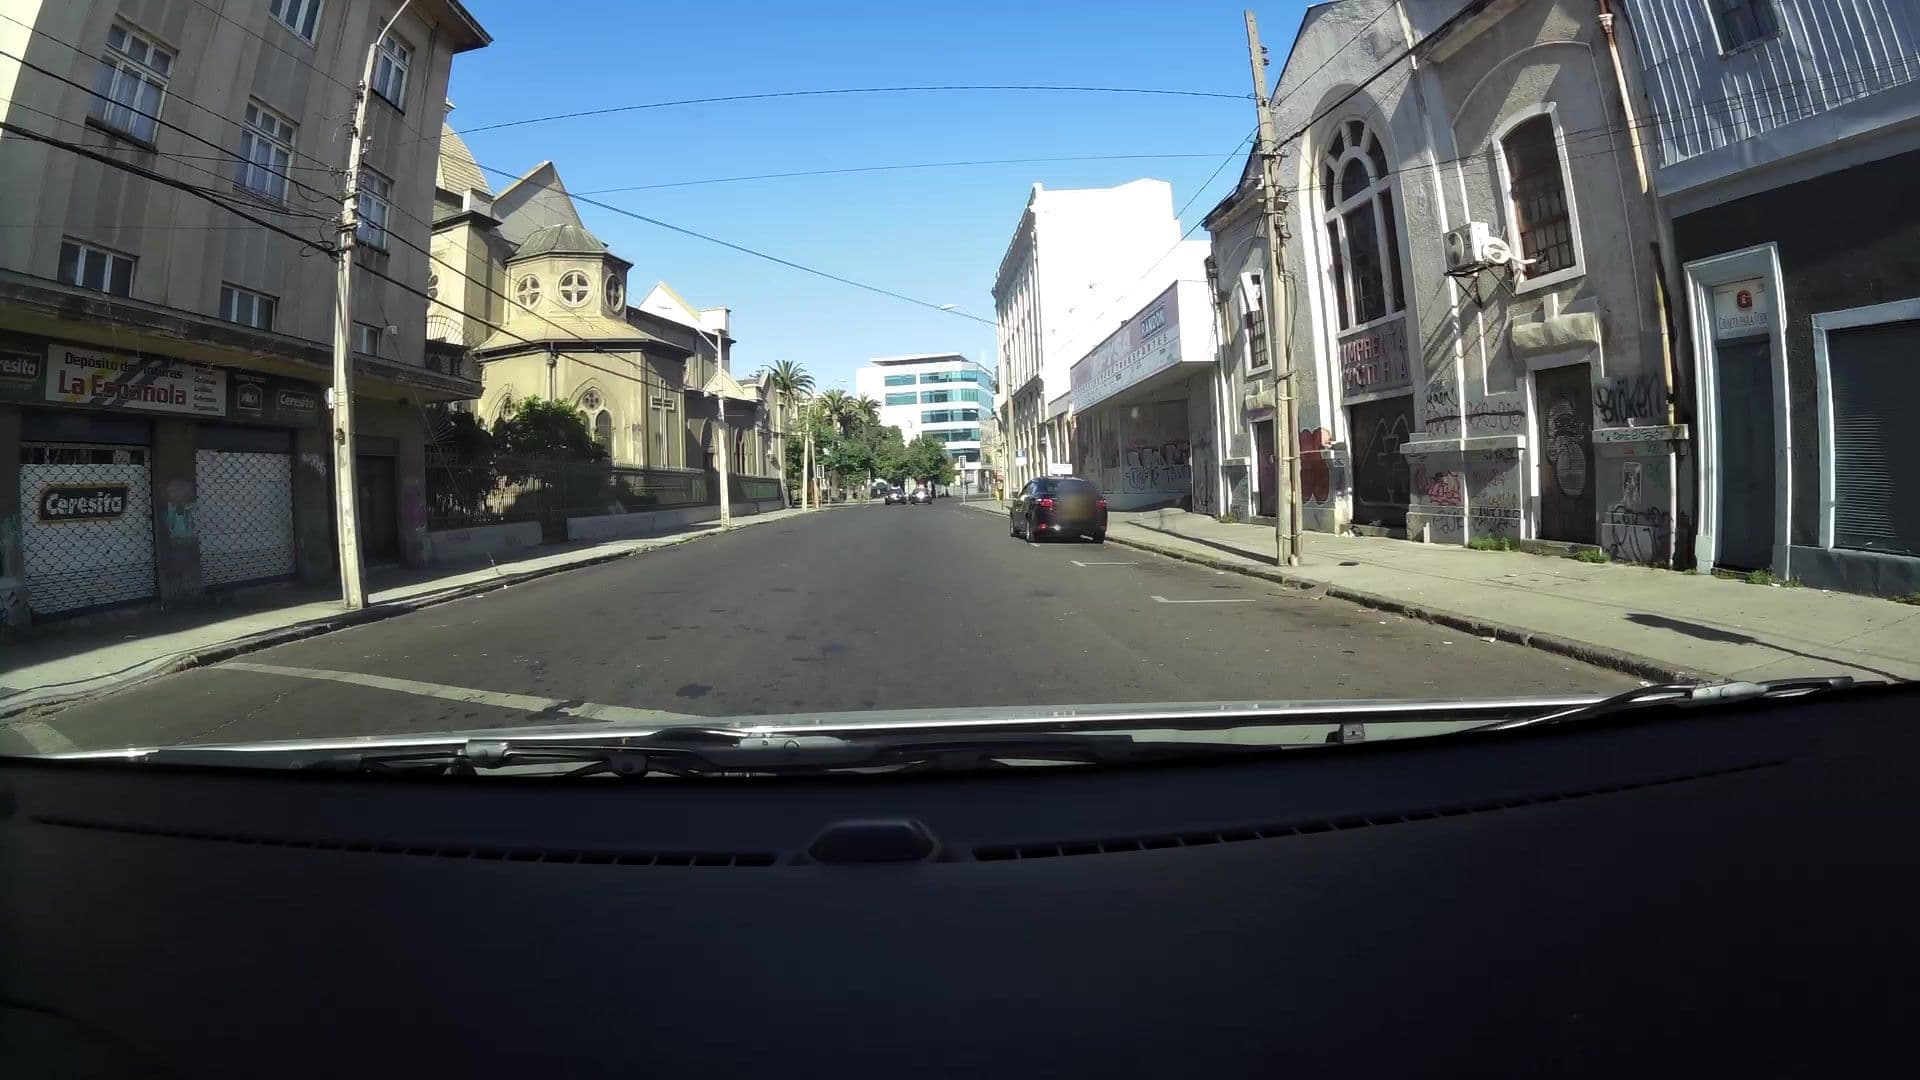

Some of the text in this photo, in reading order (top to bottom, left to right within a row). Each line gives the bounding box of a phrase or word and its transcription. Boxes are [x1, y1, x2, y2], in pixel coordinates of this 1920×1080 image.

[64, 351, 118, 371] Depósito
[58, 369, 84, 395] La
[46, 491, 122, 515] Ceresita
